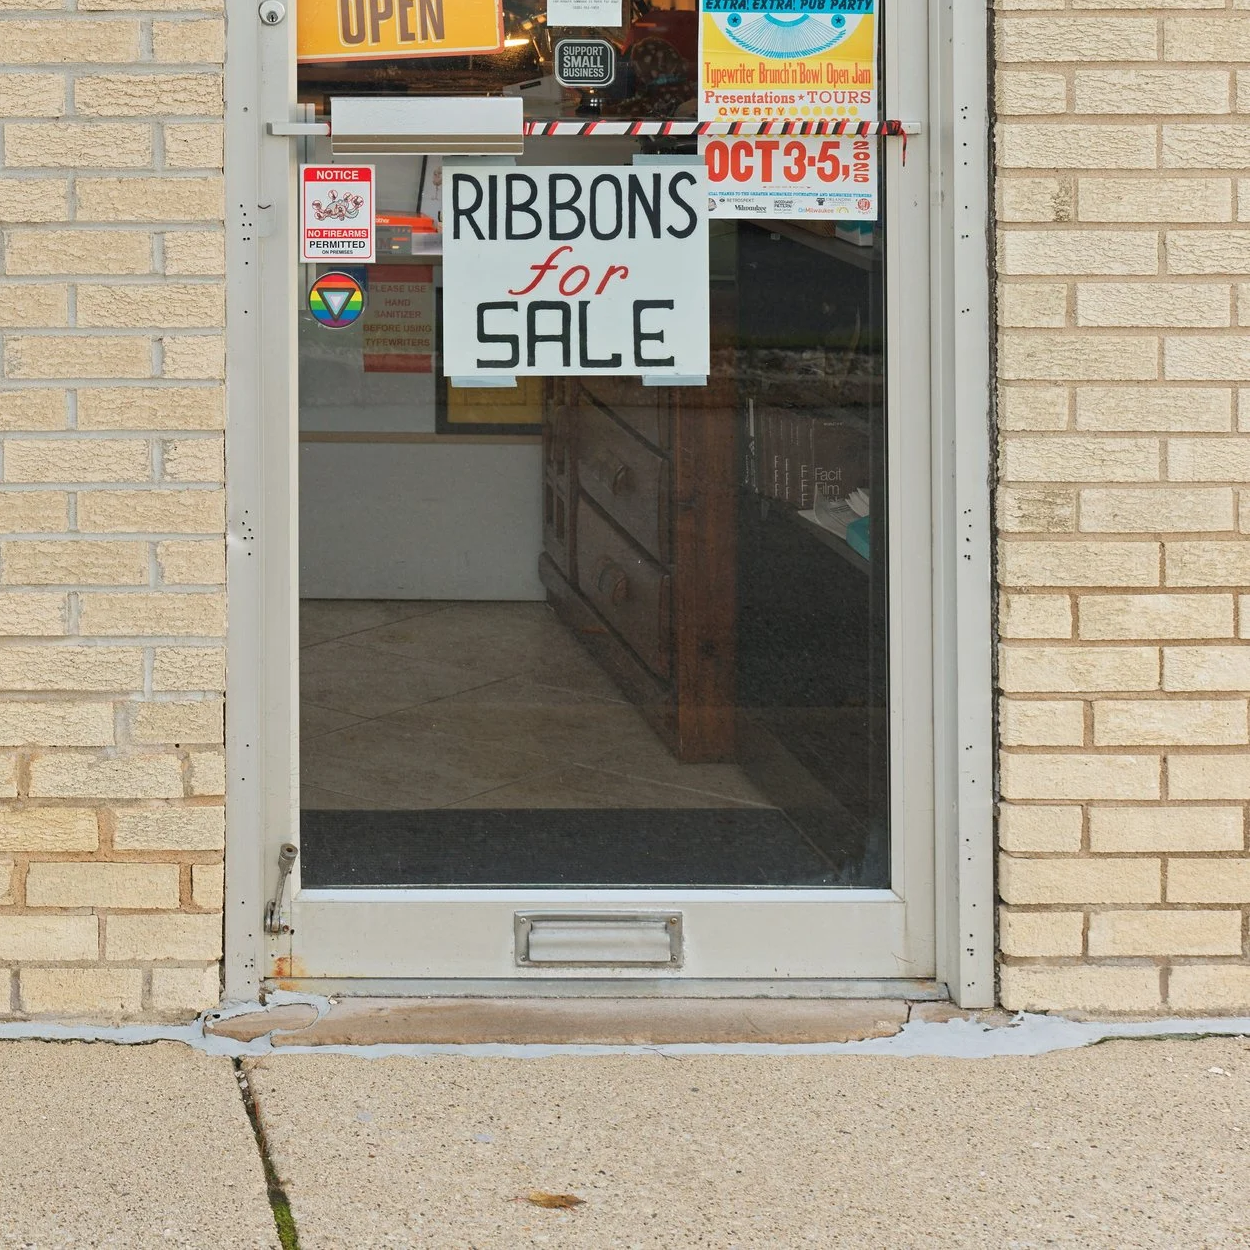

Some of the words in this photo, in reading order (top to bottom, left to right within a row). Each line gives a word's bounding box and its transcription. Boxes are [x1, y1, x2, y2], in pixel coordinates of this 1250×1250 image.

[830, 0, 873, 10] PARTY
[563, 46, 603, 57] SUPPORT
[563, 56, 604, 68] SMALL
[563, 67, 604, 78] BUSINESS
[704, 62, 756, 87] Typewriter
[826, 63, 849, 87] Open
[851, 62, 871, 84] Jam
[704, 92, 796, 104] Presentations
[806, 91, 871, 104] TOURS
[718, 107, 785, 115] QWERTY
[705, 140, 780, 183] OCT
[853, 141, 871, 183] 2025
[316, 171, 359, 180] NOTICE
[451, 171, 698, 241] RIBBONS
[308, 230, 321, 238] NO
[323, 230, 367, 238] FIREARMS
[309, 241, 366, 249] PERMITTED
[507, 245, 630, 297] for
[363, 324, 401, 332] BEFORE
[403, 324, 432, 332] USING
[476, 299, 675, 369] SALE
[365, 338, 430, 346] TYPEWRITERS
[814, 466, 842, 481] Facit
[814, 481, 840, 495] Film
